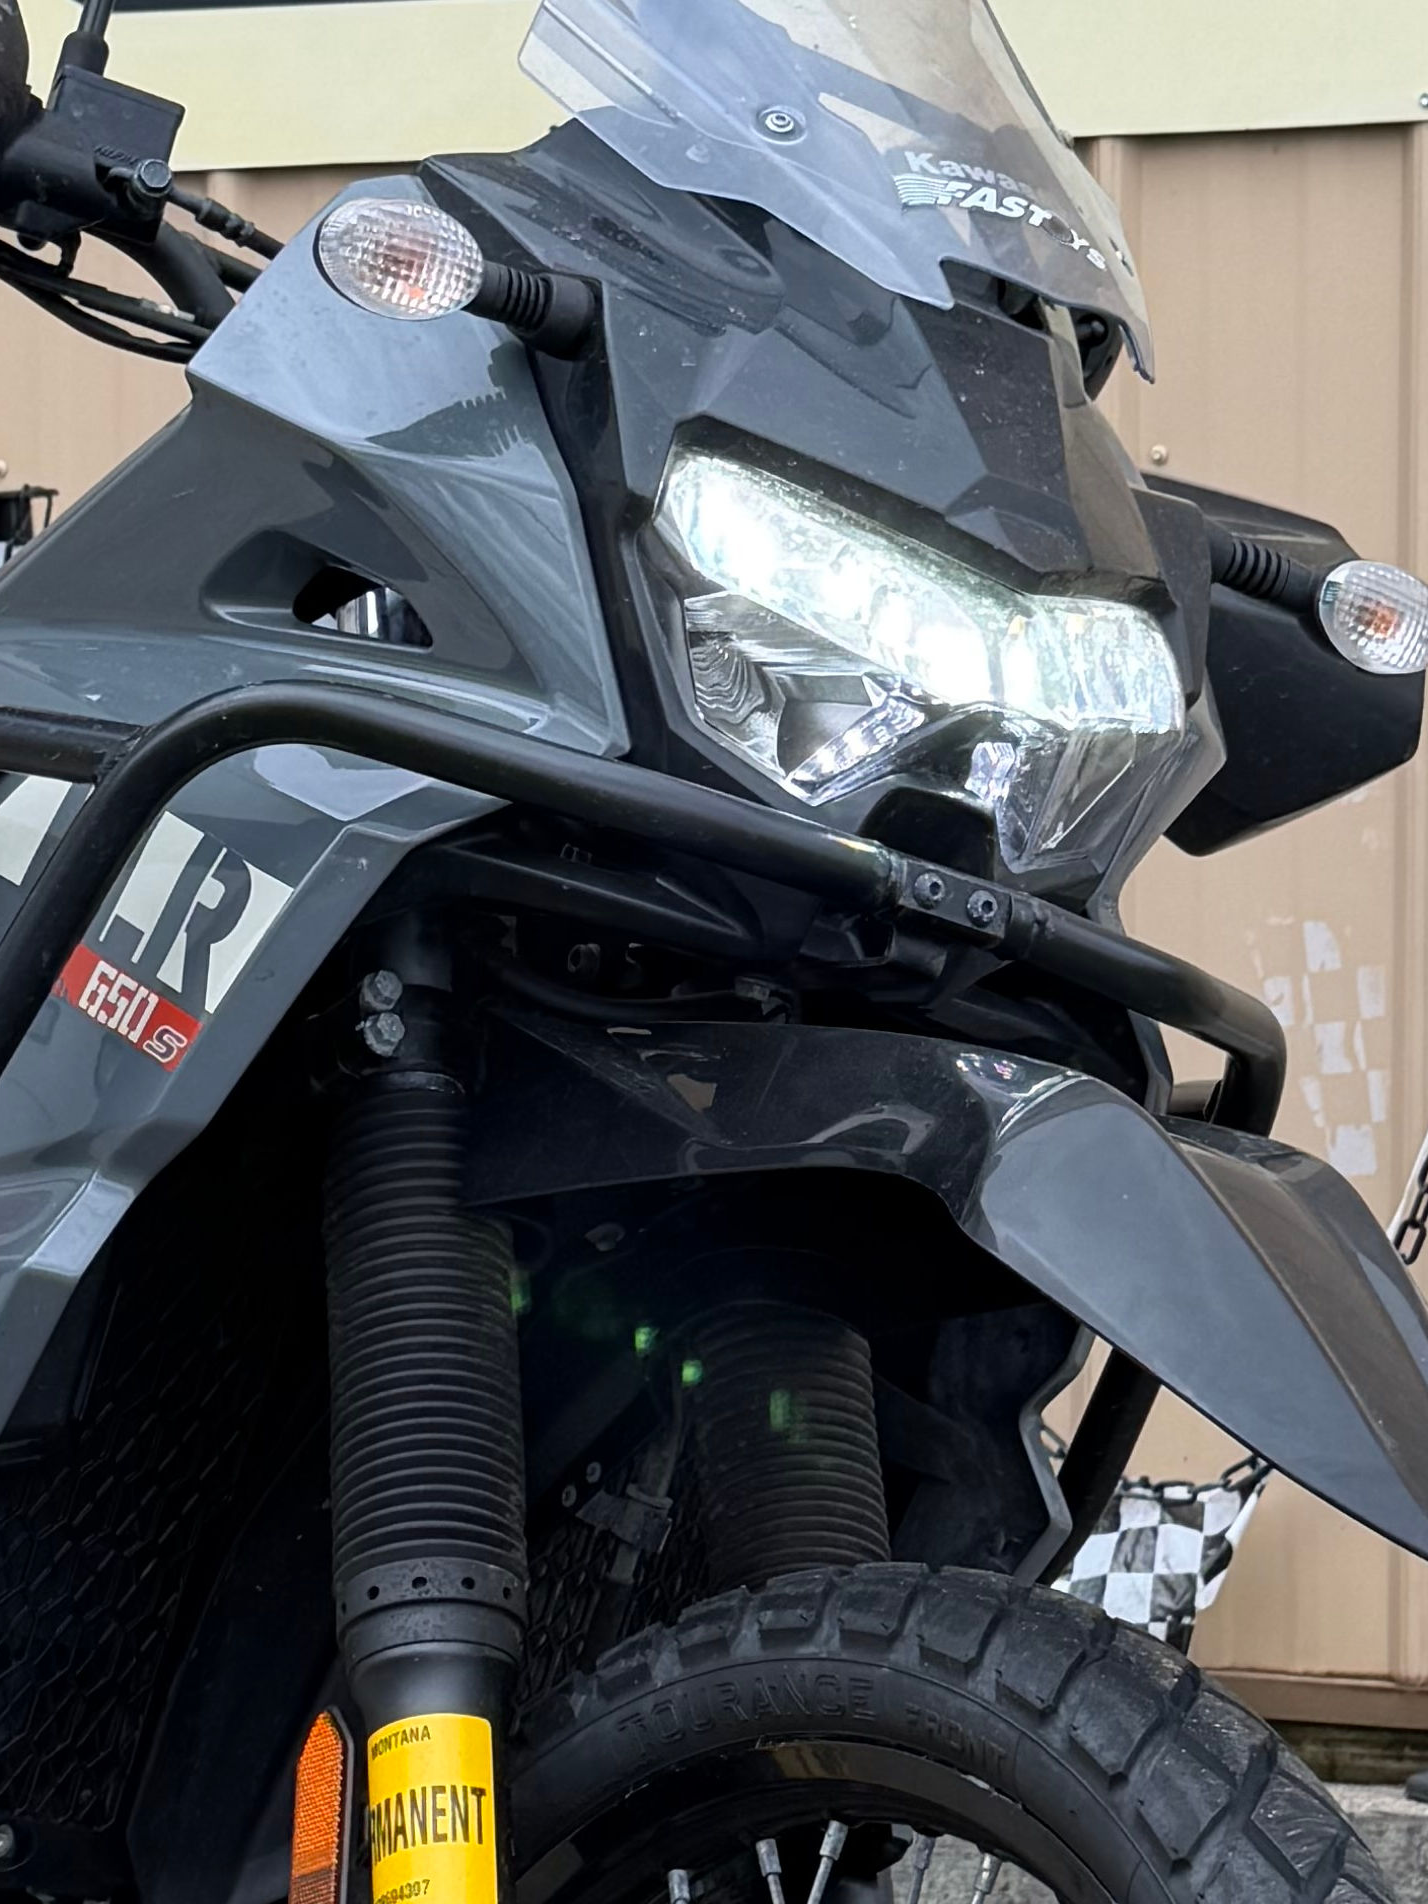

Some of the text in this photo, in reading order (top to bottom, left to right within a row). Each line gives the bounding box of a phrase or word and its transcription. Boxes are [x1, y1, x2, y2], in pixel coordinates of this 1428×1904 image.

[78, 959, 159, 1044] 650
[371, 1725, 432, 1761] MONTANA
[618, 1673, 1008, 1775] TOURANCE FRONT
